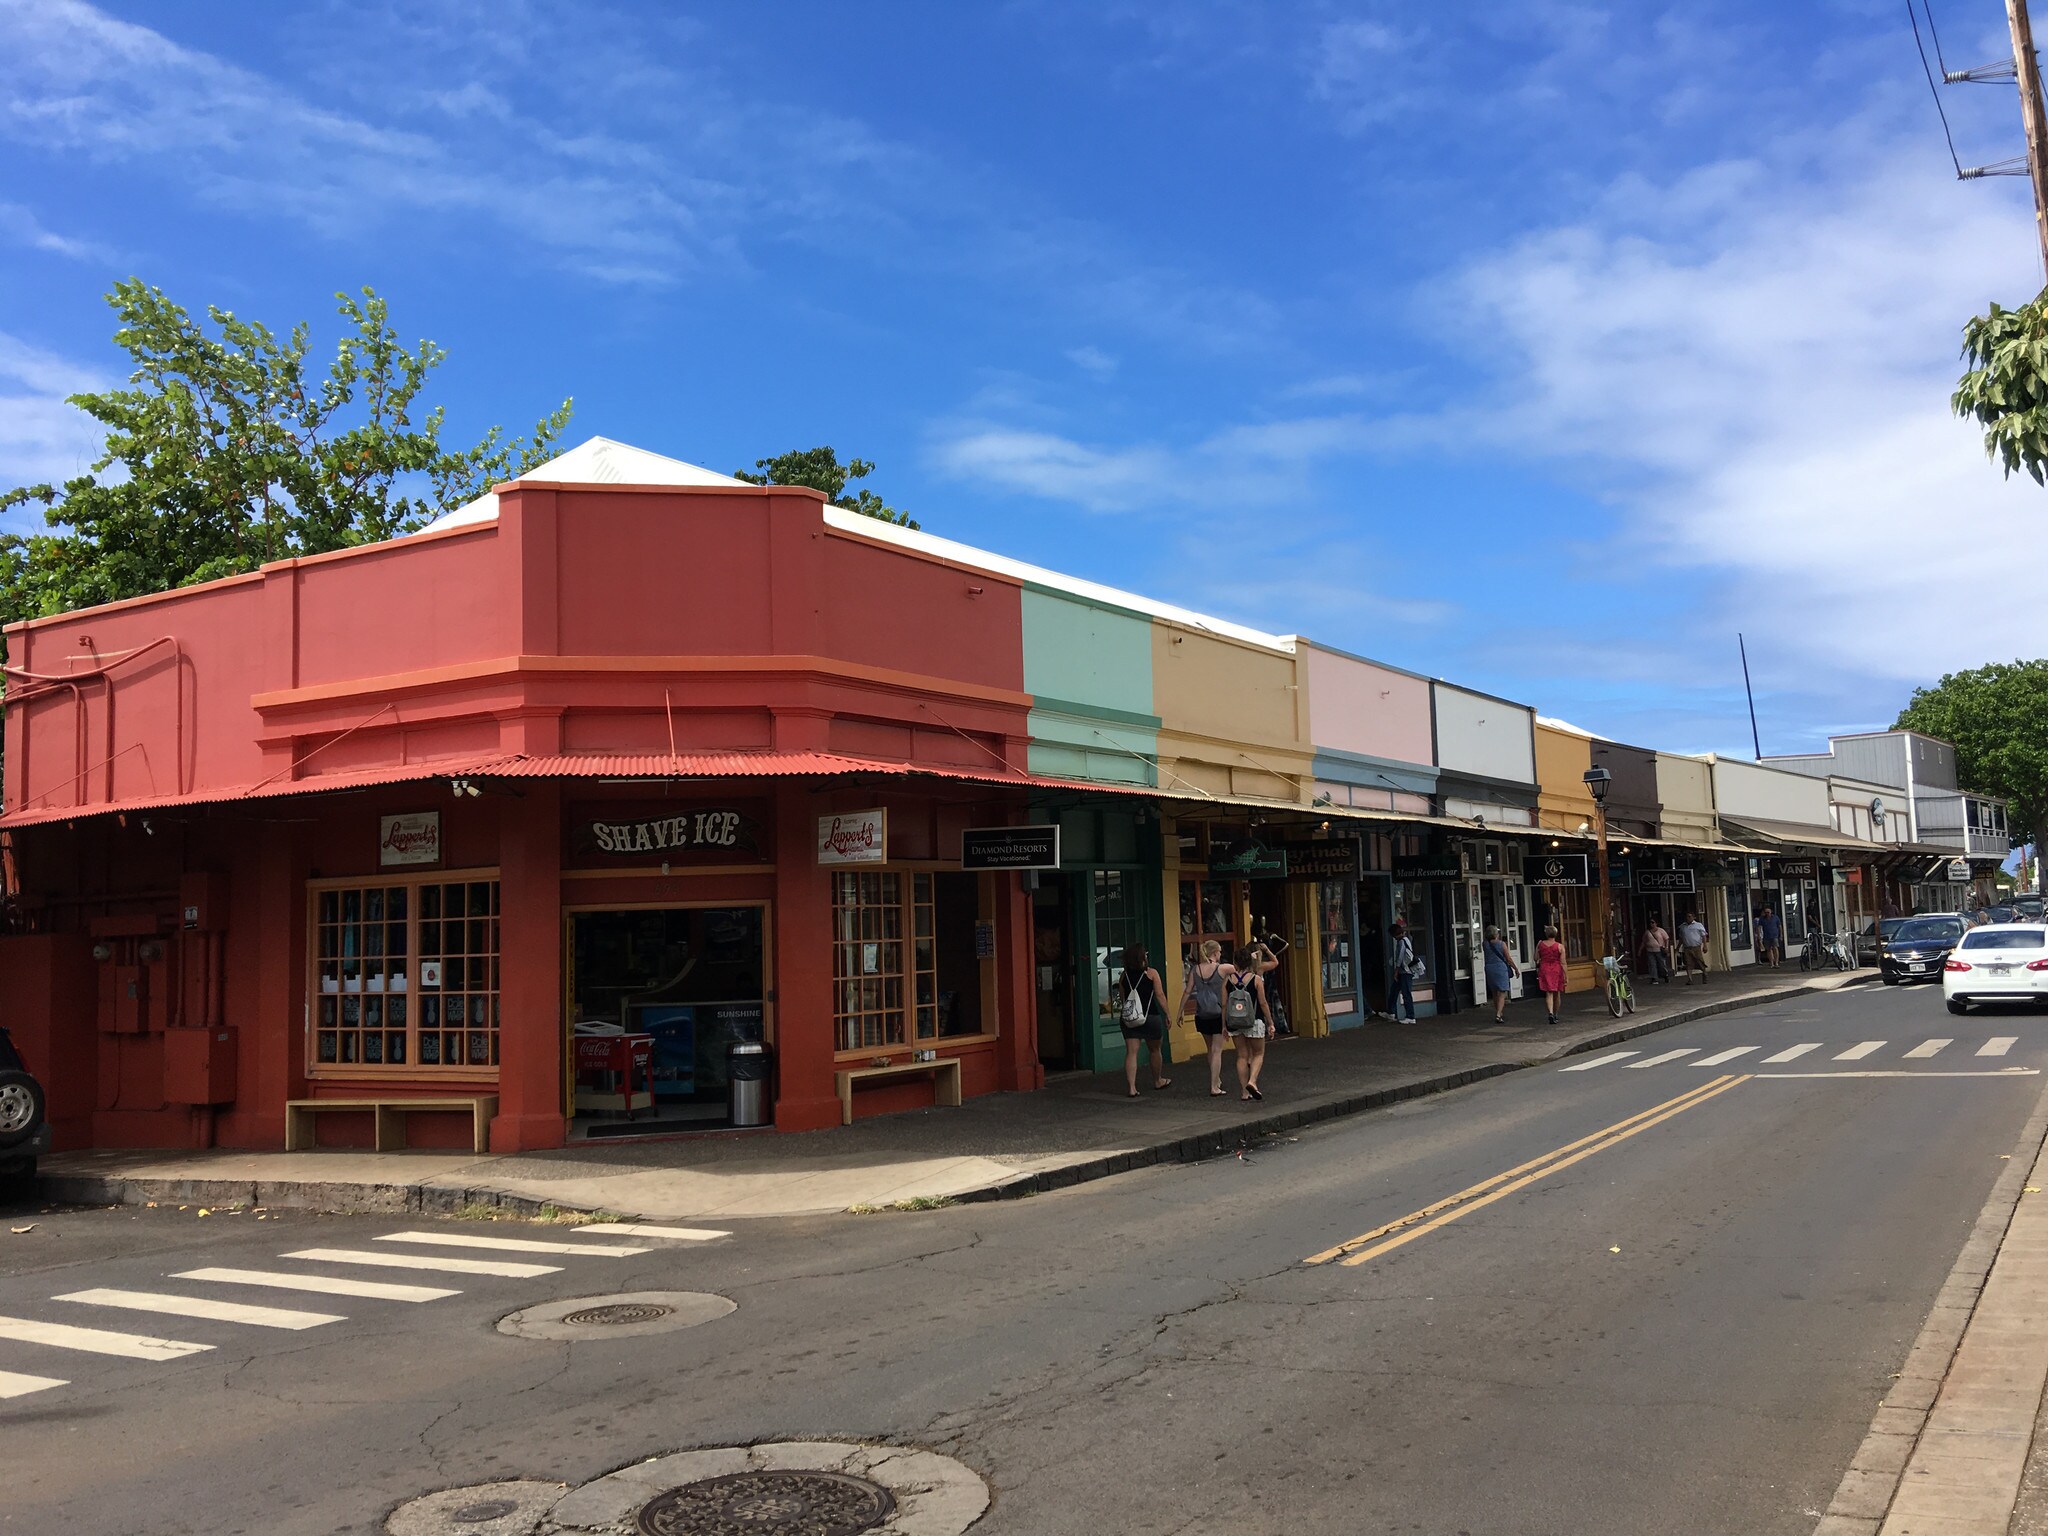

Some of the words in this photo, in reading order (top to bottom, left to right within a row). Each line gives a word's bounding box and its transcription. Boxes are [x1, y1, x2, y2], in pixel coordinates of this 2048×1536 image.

[593, 817, 688, 851] SHAVE
[694, 812, 740, 846] ICE
[824, 817, 874, 854] Lappert's
[971, 846, 1012, 855] DIAMOND
[1013, 844, 1048, 853] RESORTS
[1287, 844, 1351, 858] arina's
[987, 855, 999, 863] Stay
[1287, 861, 1355, 877] outique
[1396, 866, 1416, 878] Maui
[1417, 867, 1458, 877] Resortwear
[1778, 862, 1811, 874] VANS
[1640, 873, 1691, 886] CHAPEL
[717, 1009, 761, 1018] SUNSHINE
